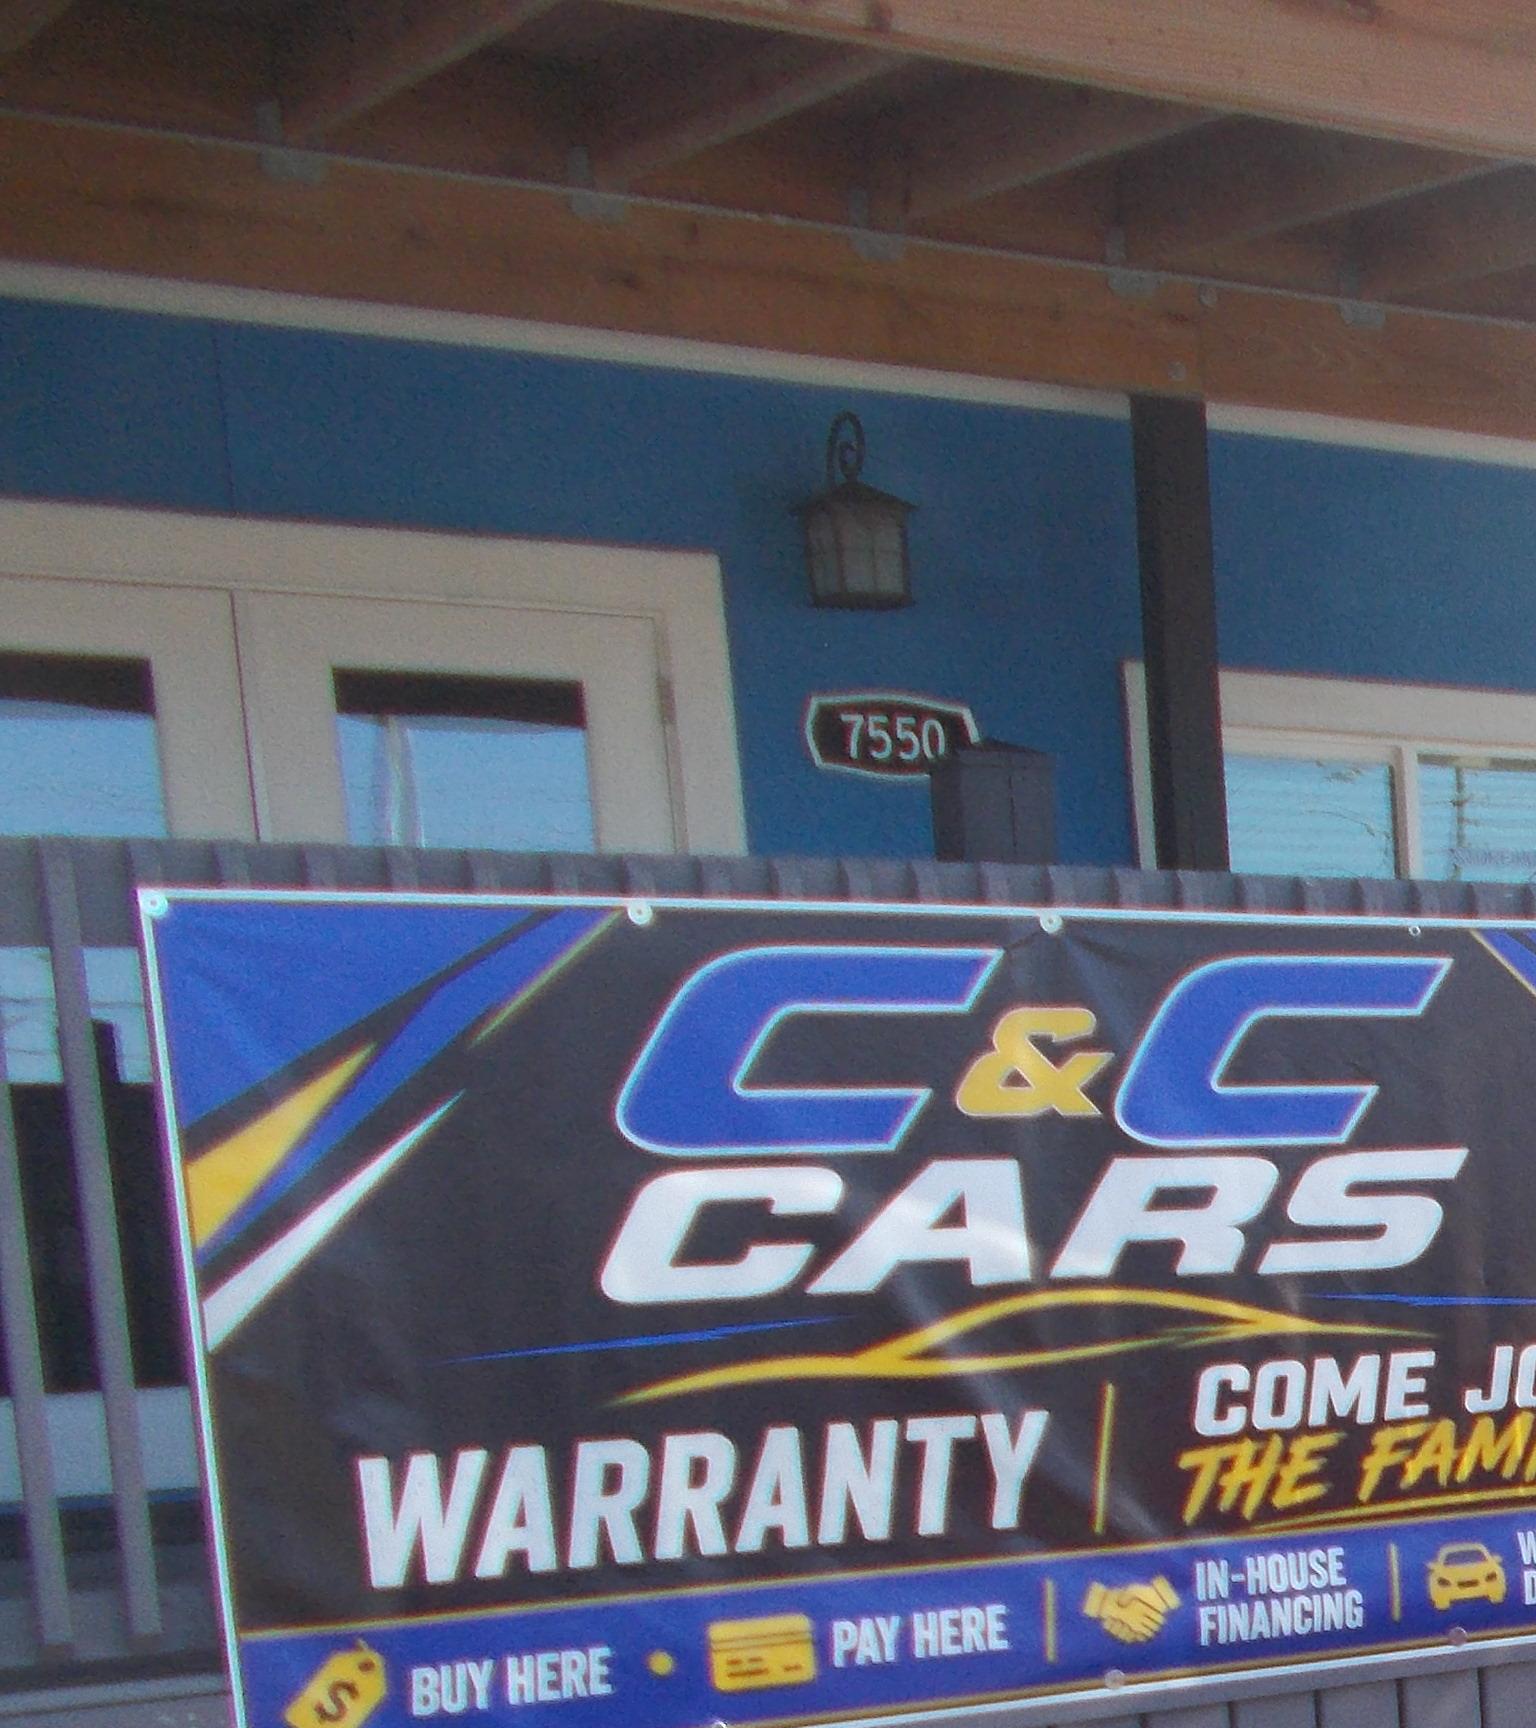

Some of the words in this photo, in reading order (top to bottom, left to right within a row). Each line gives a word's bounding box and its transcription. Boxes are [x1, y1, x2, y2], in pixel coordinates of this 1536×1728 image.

[840, 713, 945, 761] 7550
[600, 1147, 1469, 1304] CARS
[1192, 1350, 1437, 1437] COME
[357, 1409, 1050, 1591] WARRANTY
[1177, 1431, 1346, 1527] THE
[1195, 1547, 1348, 1601] IN-HOUSE
[831, 1615, 900, 1668] PAY
[911, 1603, 1010, 1659] HERE
[1199, 1589, 1365, 1647] FINANCING
[411, 1659, 495, 1718] BUY
[506, 1646, 615, 1706] HERE
